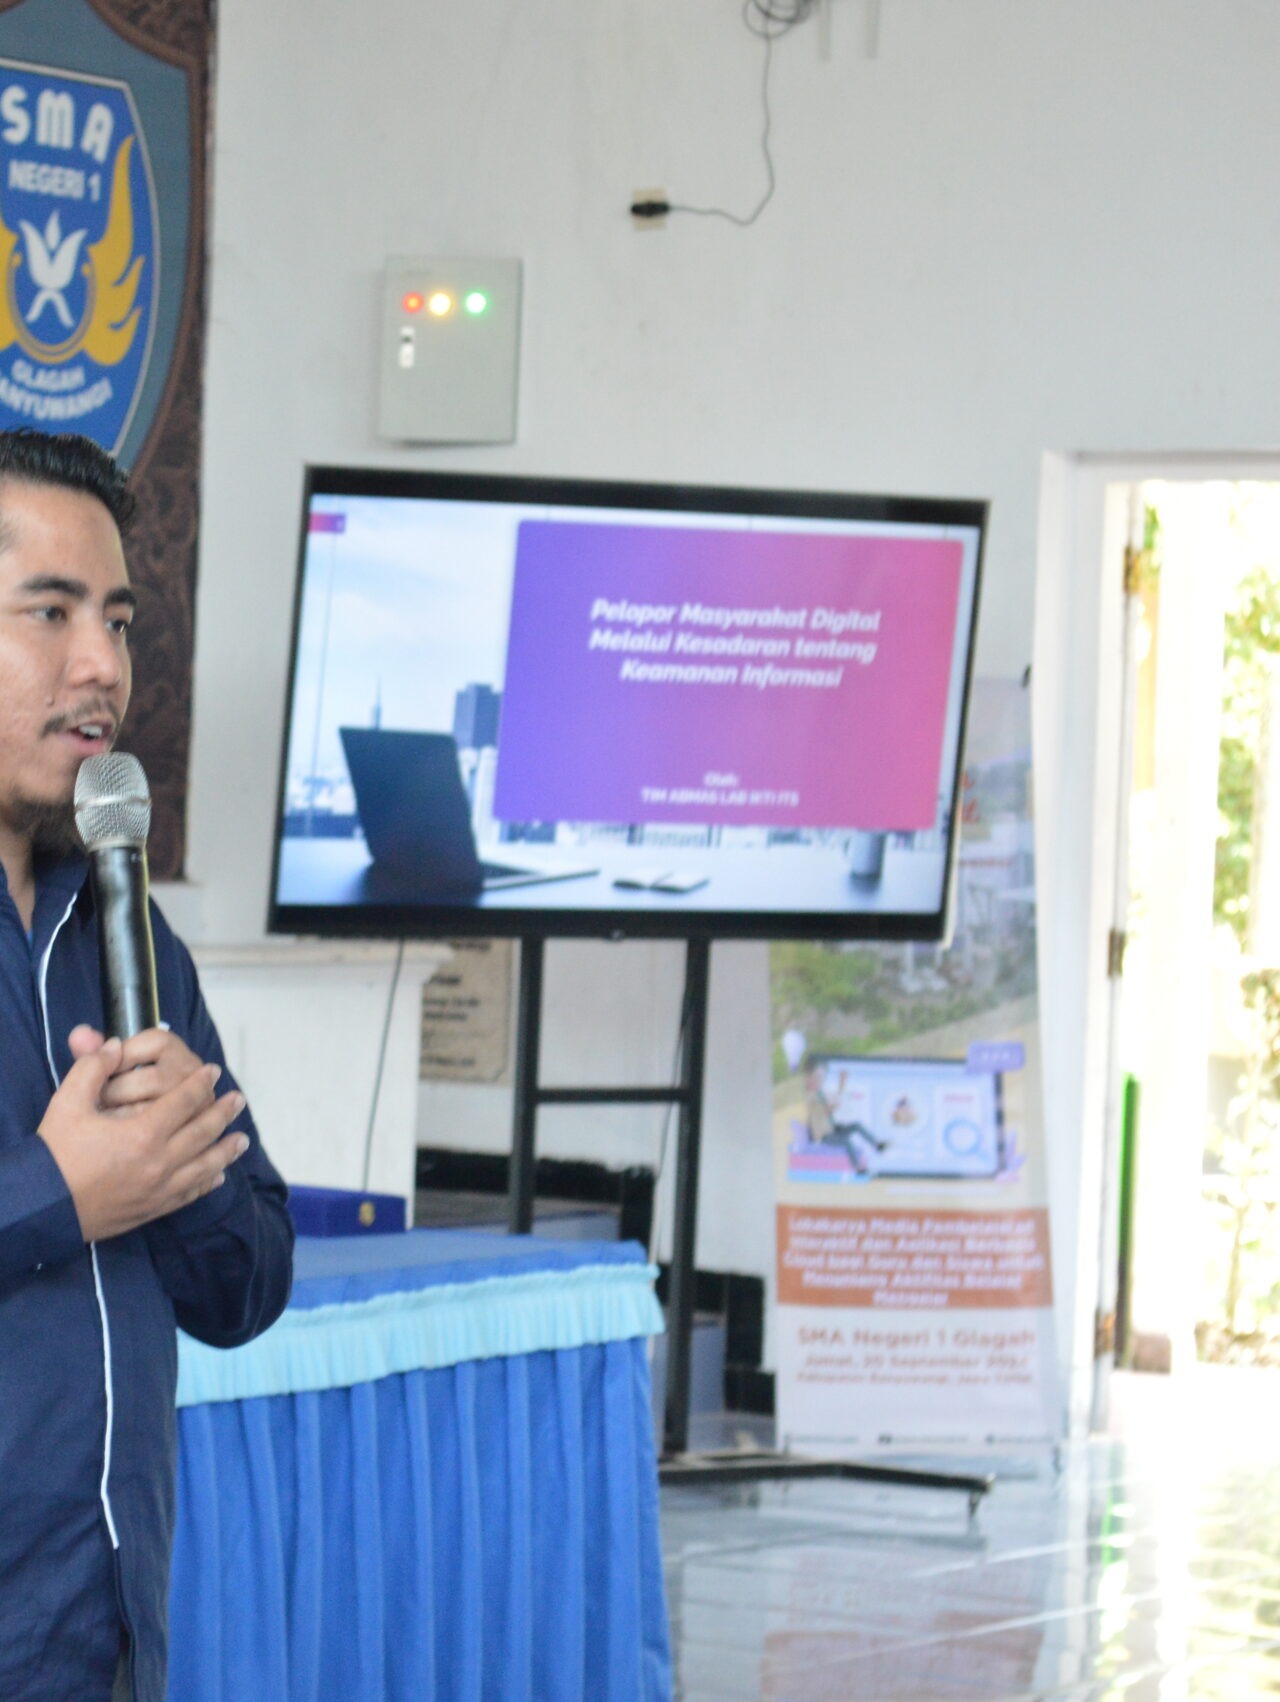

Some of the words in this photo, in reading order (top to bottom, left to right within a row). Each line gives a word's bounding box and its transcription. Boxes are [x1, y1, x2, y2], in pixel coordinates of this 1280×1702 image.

[0, 84, 114, 164] SMA
[8, 159, 86, 200] NEGERI
[88, 172, 101, 203] 1
[11, 358, 86, 391] GLAGAH
[590, 598, 676, 627] Pelopor
[680, 602, 807, 632] Masyarakat
[811, 605, 882, 635] Digital
[588, 628, 673, 652] Melalui
[674, 631, 790, 656] Kesadaran
[795, 636, 878, 666] tentang
[621, 658, 738, 684] Keamanan
[742, 662, 844, 690] Informasi
[797, 1327, 844, 1346] SMA
[852, 1328, 929, 1349] Negeri
[951, 1328, 1035, 1350] Glagah
